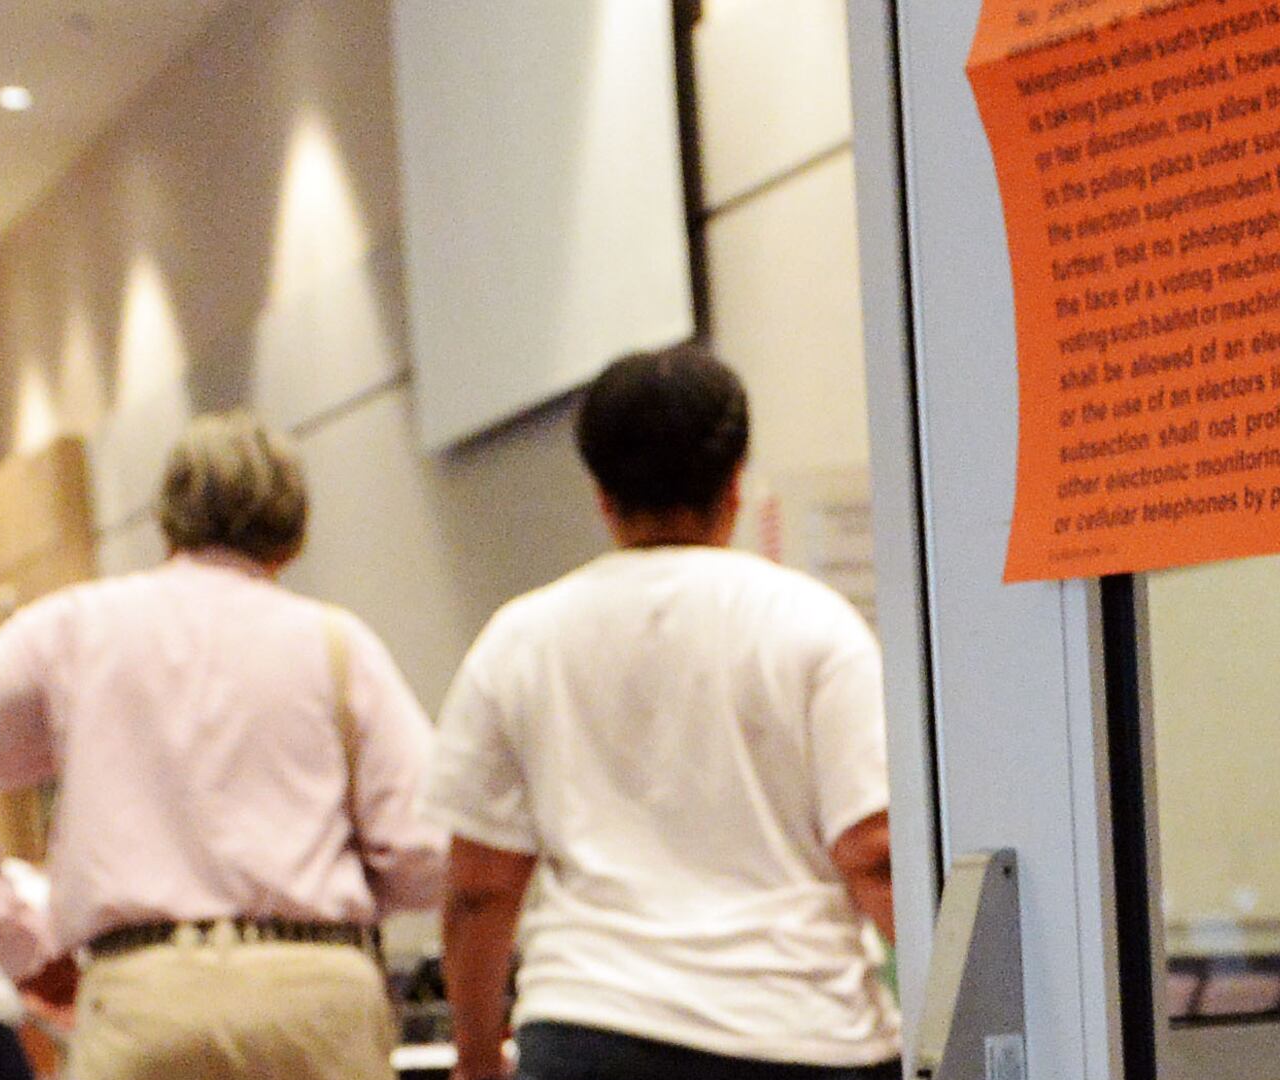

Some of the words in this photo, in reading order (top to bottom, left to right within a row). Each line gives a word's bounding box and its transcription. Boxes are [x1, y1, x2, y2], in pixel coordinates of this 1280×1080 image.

[1265, 4, 1280, 25] is
[1028, 116, 1044, 134] is
[1044, 100, 1096, 130] taking
[1035, 152, 1053, 172] or
[1055, 145, 1083, 164] her
[1175, 110, 1212, 132] may
[1217, 96, 1261, 123] allow
[1043, 189, 1058, 208] in
[1061, 182, 1087, 202] the
[1150, 154, 1194, 185] place
[1198, 139, 1248, 168] under
[1048, 223, 1072, 242] the
[1114, 242, 1146, 268] that
[1152, 238, 1173, 256] no
[1055, 298, 1080, 318] the
[1084, 290, 1119, 311] face
[1124, 280, 1141, 304] of
[1159, 268, 1213, 294] voting
[1058, 330, 1108, 353] voting
[1151, 307, 1199, 336] ballot
[1200, 305, 1218, 325] or
[1060, 366, 1098, 391] shall
[1103, 363, 1123, 383] be
[1130, 346, 1194, 378] allowed
[1199, 340, 1218, 364] of
[1224, 339, 1245, 361] an
[1058, 410, 1076, 427] or
[1081, 403, 1107, 423] the
[1112, 398, 1142, 418] use
[1147, 389, 1165, 411] of
[1170, 388, 1191, 408] an
[1196, 374, 1265, 403] electors
[1060, 433, 1149, 463] subsection
[1159, 420, 1200, 448] shall
[1208, 414, 1238, 438] not
[1057, 477, 1100, 499] other
[1105, 464, 1190, 491] electronic
[1054, 518, 1071, 534] or
[1075, 508, 1137, 532] cellular
[1244, 486, 1266, 511] by
